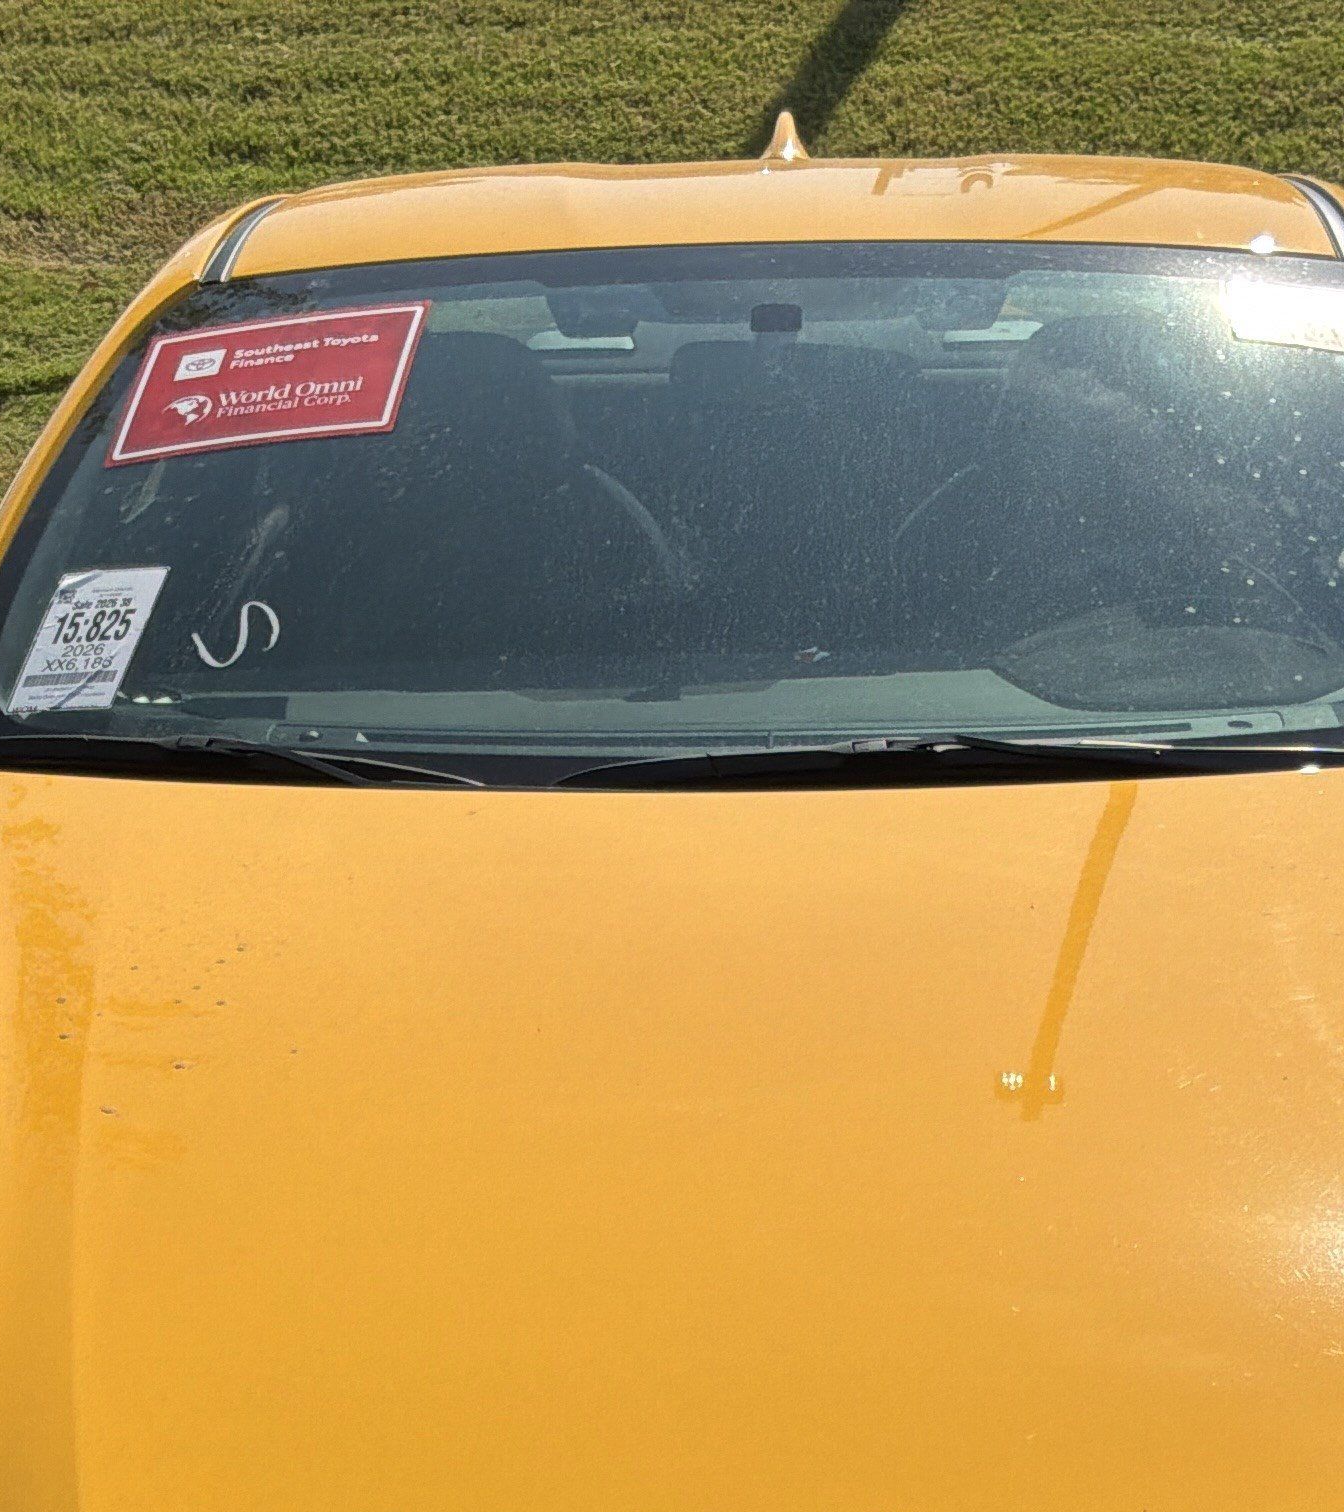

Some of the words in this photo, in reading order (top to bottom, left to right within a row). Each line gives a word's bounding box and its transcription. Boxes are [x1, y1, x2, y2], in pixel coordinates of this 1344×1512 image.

[233, 339, 320, 359] Southeast
[323, 332, 379, 348] Toyota
[229, 352, 294, 370] Finance
[218, 383, 292, 405] World
[294, 376, 363, 397] Omni
[217, 398, 298, 419] Financial
[303, 392, 352, 409] Corp.
[52, 608, 138, 645] 15:825
[61, 643, 106, 658] 2026
